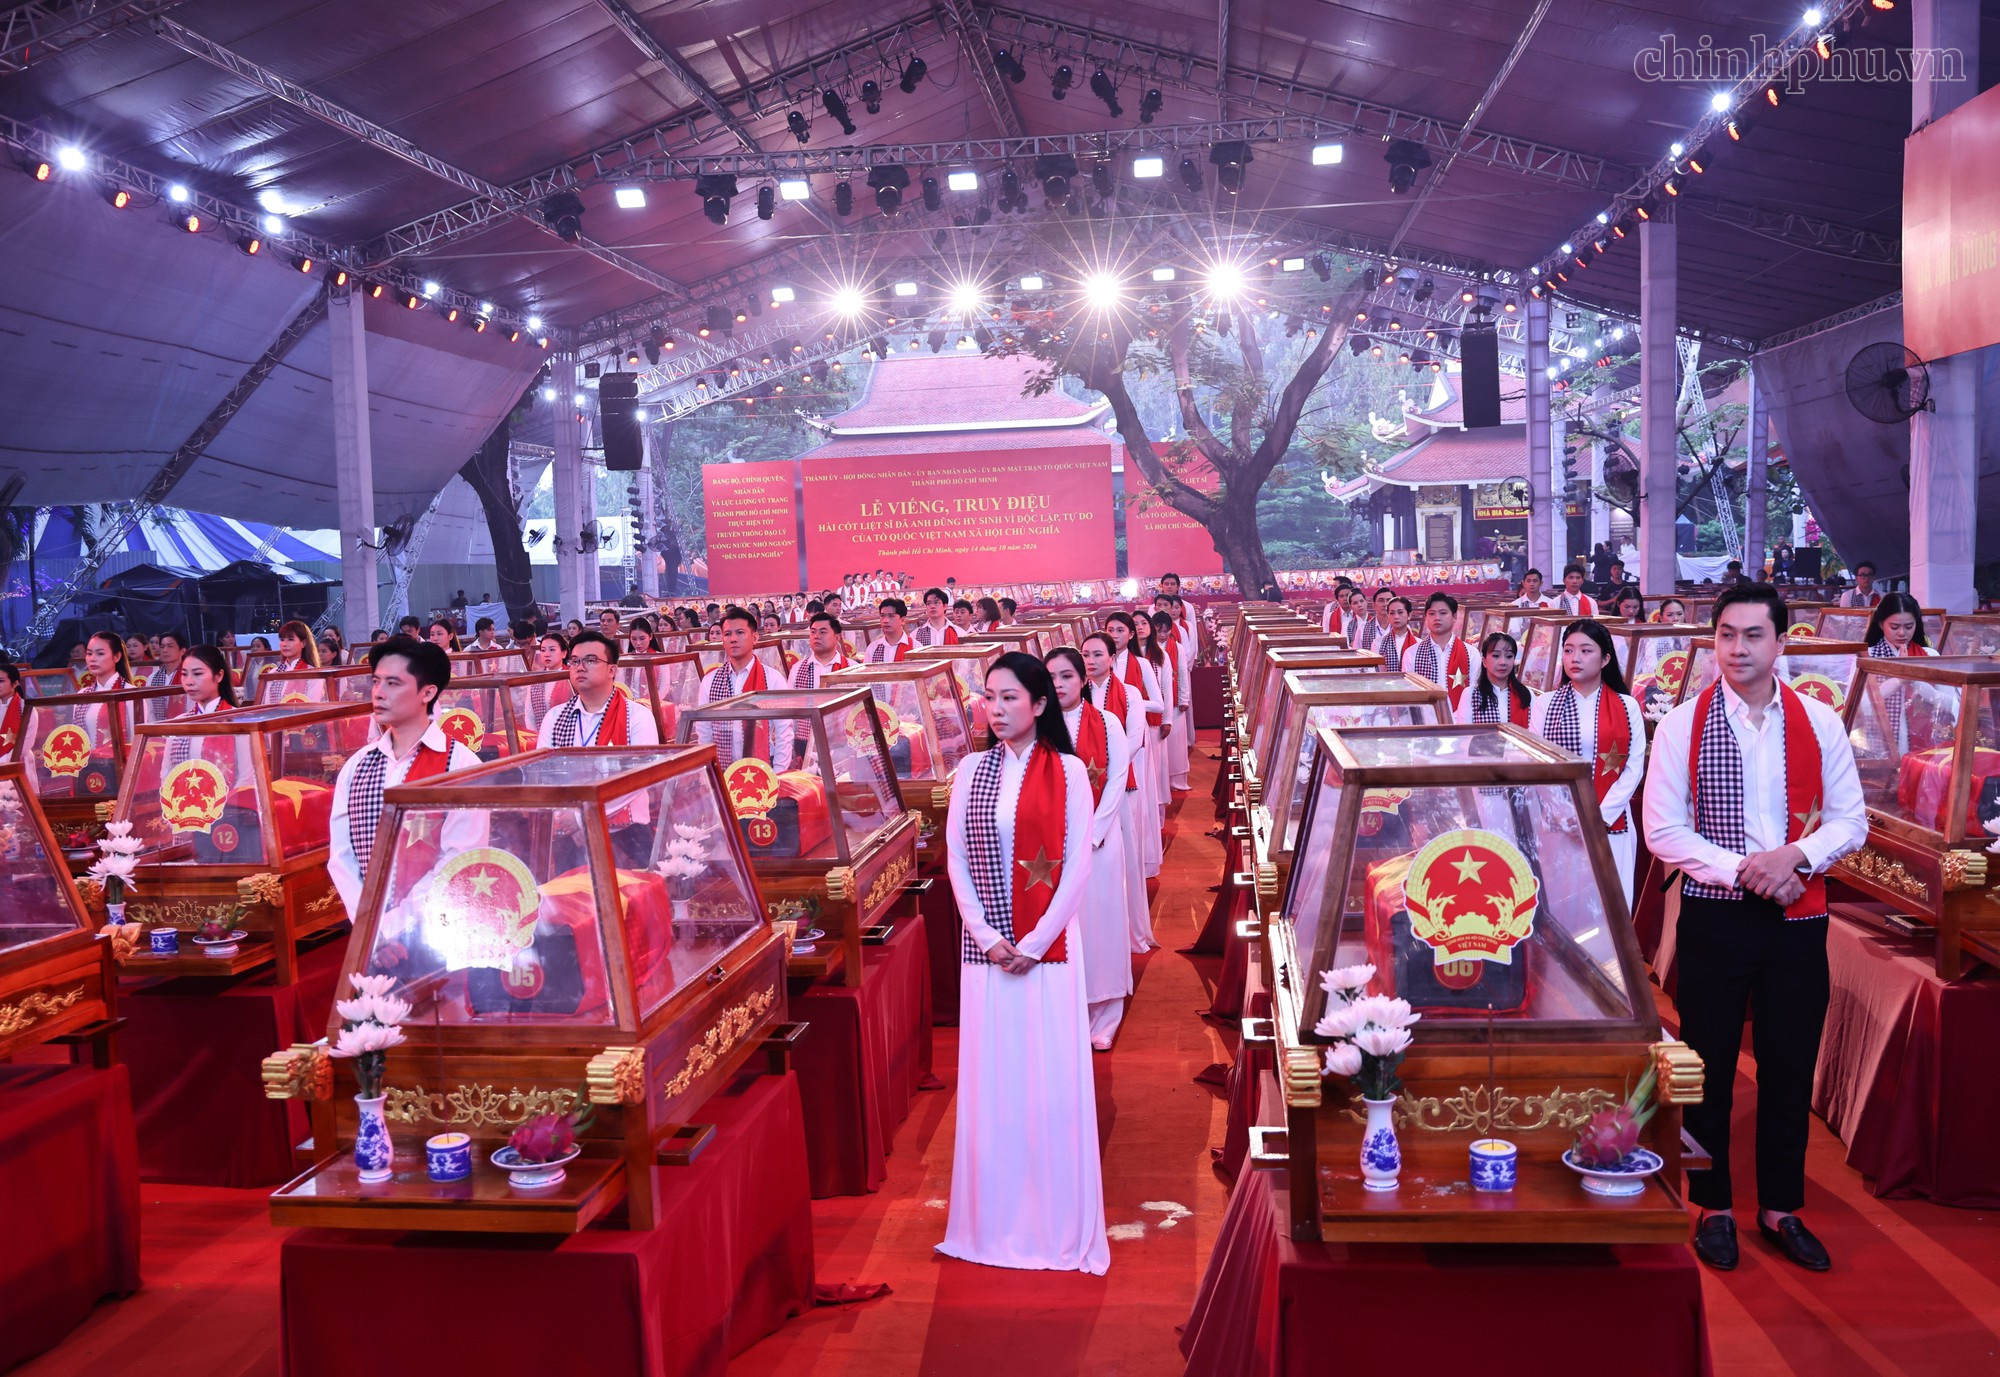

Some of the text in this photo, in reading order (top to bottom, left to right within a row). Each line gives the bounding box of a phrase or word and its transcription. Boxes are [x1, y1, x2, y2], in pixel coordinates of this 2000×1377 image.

[898, 470, 912, 478] DÂN
[942, 468, 961, 476] NHÂN
[1074, 461, 1092, 470] VIỆT
[1092, 460, 1108, 468] NAM
[979, 476, 998, 484] MINH
[768, 496, 789, 504] TRANG
[860, 493, 1051, 517] LỄ VIẾNG, TRUY ĐIỆU
[712, 510, 734, 518] THÀNH
[818, 522, 836, 532] HÀI
[838, 522, 858, 532] CỐT
[860, 521, 882, 532] LIỆT
[884, 520, 894, 529] SĨ
[895, 518, 909, 529] ĐÃ
[910, 519, 932, 528] ANH
[934, 517, 961, 527] DŨNG
[963, 518, 978, 526] HY
[979, 516, 1002, 525] SINH
[1004, 514, 1015, 524] VÌ
[1017, 514, 1038, 524] ĐỘC
[1062, 512, 1078, 522] TỰ
[1078, 512, 1094, 520] DO
[852, 534, 872, 543] CỦA
[890, 531, 918, 542] QUỐC
[920, 530, 942, 541] VIỆT
[944, 530, 967, 539] NAM
[968, 528, 983, 538] XÃ
[984, 528, 1002, 538] HỘI
[1005, 526, 1026, 536] CHỦ
[1028, 524, 1060, 536] NGHĨA
[90, 778, 102, 788] 24
[217, 831, 234, 844] 12
[753, 824, 772, 838] 13
[508, 965, 535, 987] 05
[1443, 960, 1474, 977] 06
